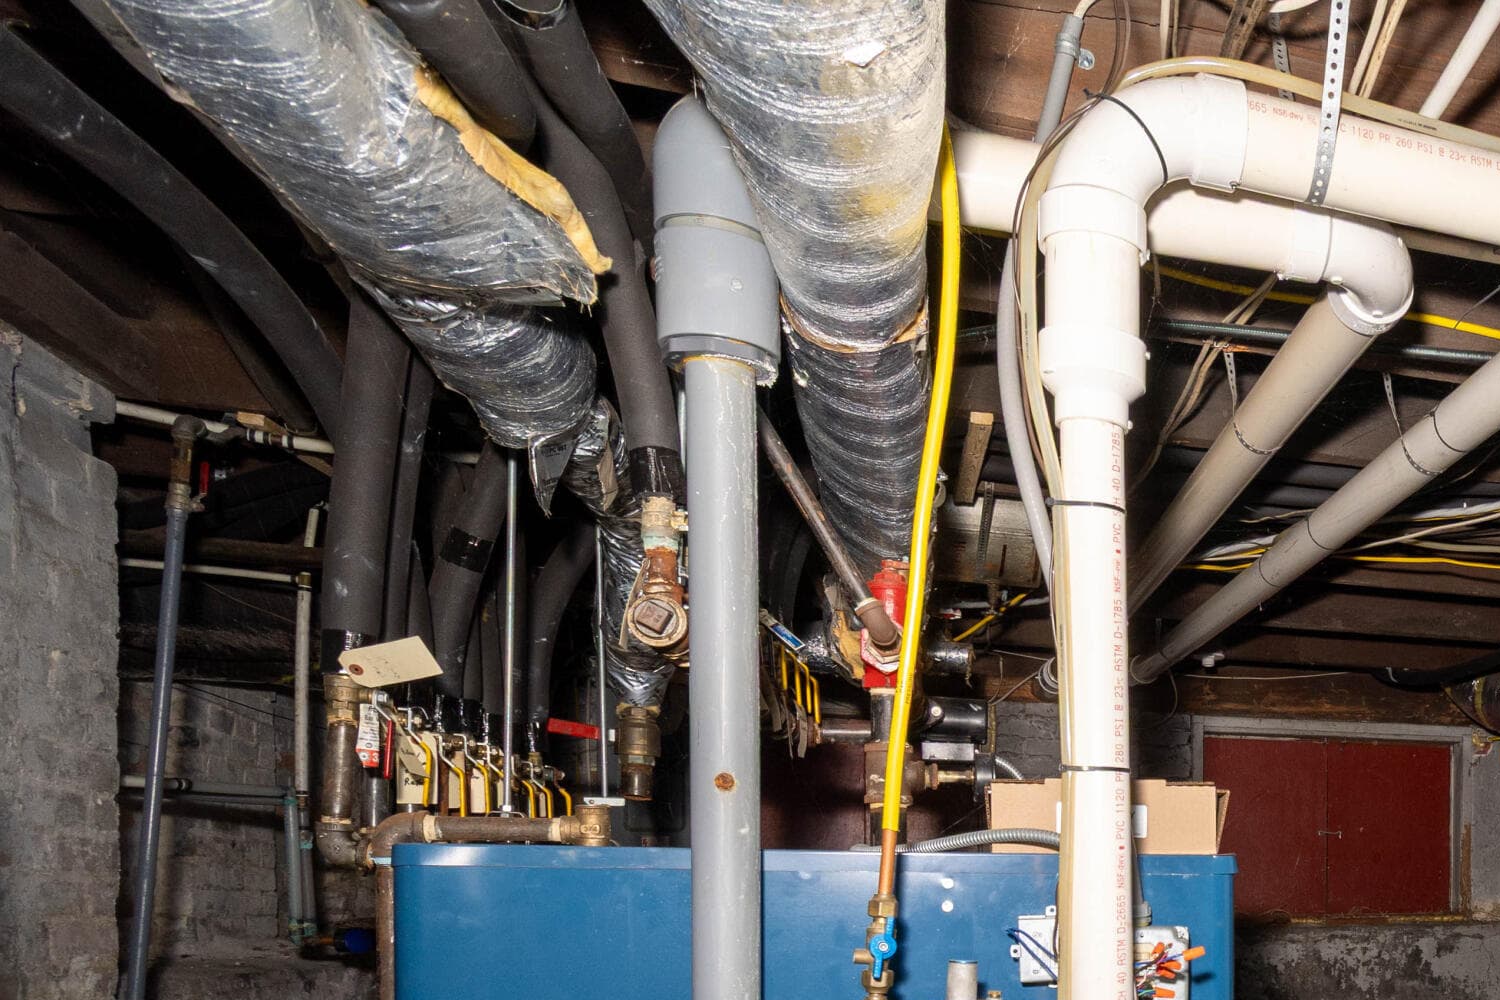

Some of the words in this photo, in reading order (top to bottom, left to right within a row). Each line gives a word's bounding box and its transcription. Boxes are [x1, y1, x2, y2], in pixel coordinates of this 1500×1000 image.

[1248, 99, 1268, 115] 665
[1351, 124, 1375, 141] 1120
[1379, 132, 1391, 144] PR
[1417, 142, 1434, 155] PSI
[1470, 154, 1493, 170] ASTM
[1111, 431, 1122, 473] D-1785
[1111, 477, 1122, 492] 40
[1111, 494, 1122, 517] SH
[1112, 523, 1122, 544] PVC
[1112, 598, 1123, 639] D-1785
[1113, 643, 1124, 671] ASTM
[1113, 718, 1125, 737] PSI
[1113, 743, 1125, 763] 280
[1114, 787, 1126, 813] 1120
[1114, 819, 1126, 840] PVC
[1116, 938, 1128, 966] ASTM
[1116, 970, 1128, 984] 40
